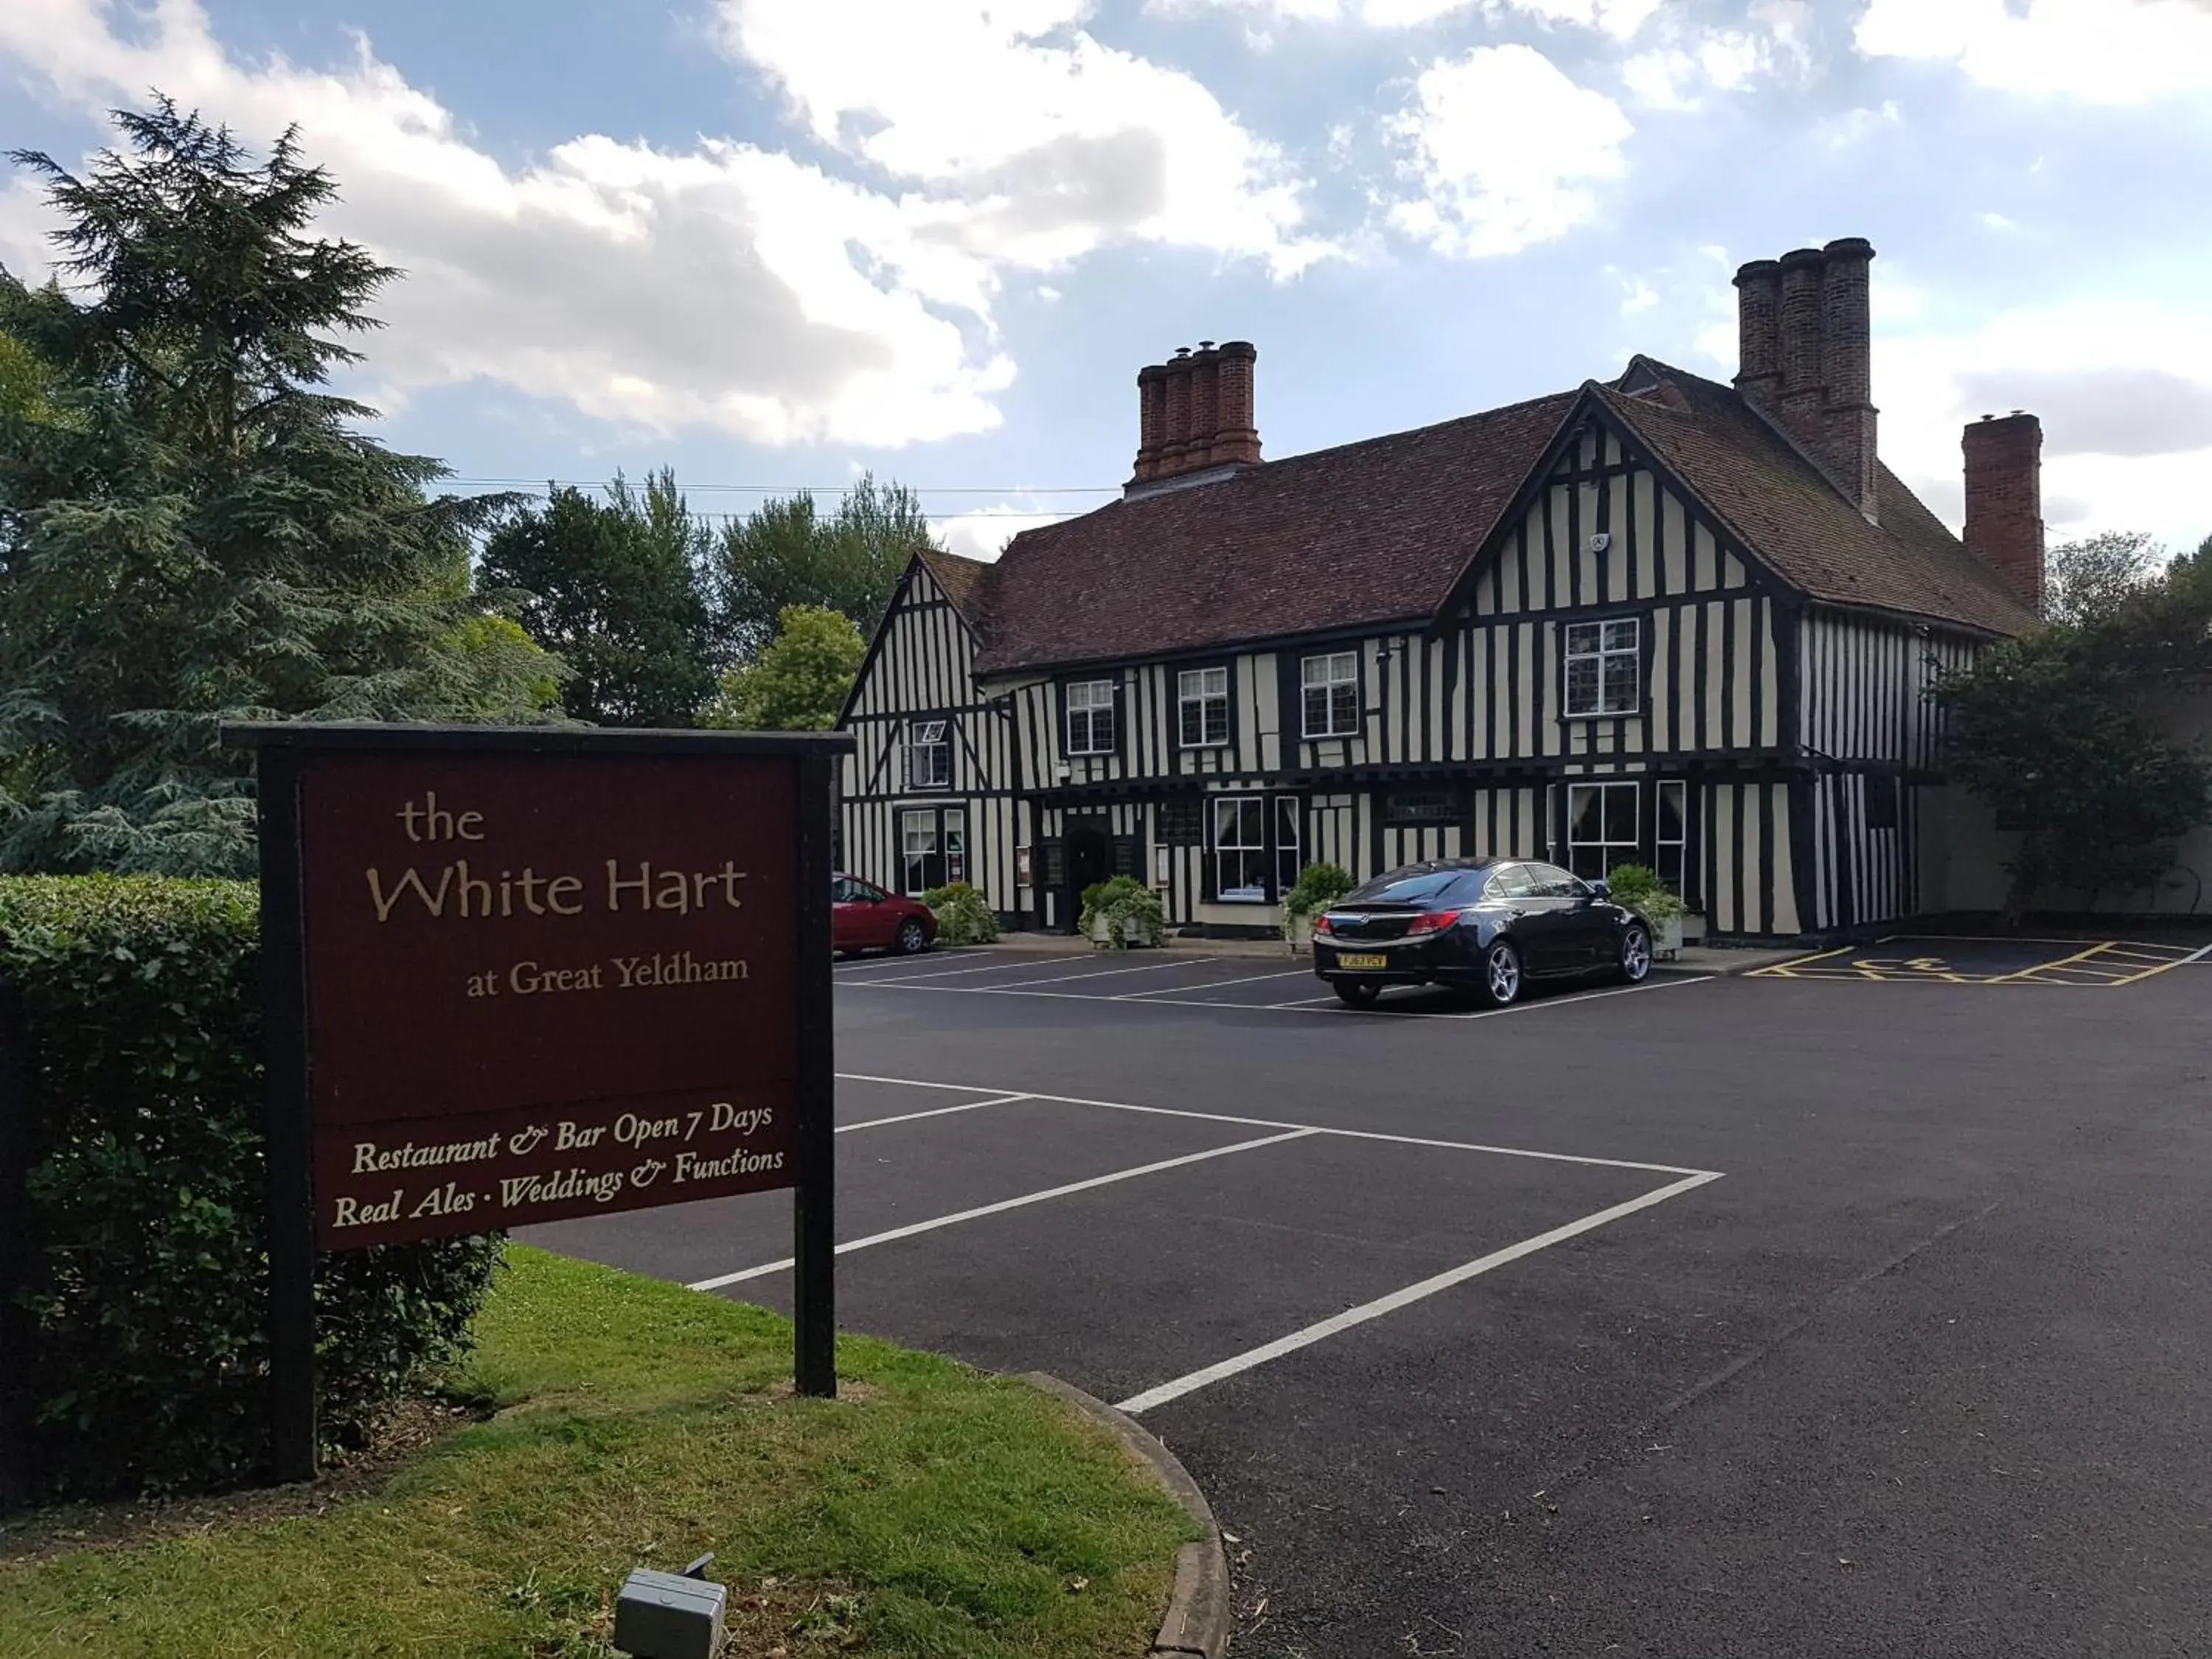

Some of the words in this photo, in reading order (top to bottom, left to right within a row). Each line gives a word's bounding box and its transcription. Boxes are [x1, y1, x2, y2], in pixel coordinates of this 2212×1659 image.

[397, 790, 484, 842] the
[366, 859, 582, 922] White
[606, 859, 747, 915] Hart
[467, 970, 498, 998] at
[509, 961, 602, 994] Great
[611, 950, 748, 987] Yeldham
[352, 1132, 501, 1174] Restaurant
[509, 1125, 549, 1155] &
[554, 1121, 606, 1151] Bar
[614, 1113, 678, 1149] Open
[685, 1112, 703, 1141] 7
[709, 1103, 773, 1135] Days
[333, 1189, 402, 1227] Real
[408, 1182, 476, 1219] Ales
[500, 1168, 625, 1208] Weddings
[630, 1158, 667, 1187] &
[673, 1148, 785, 1183] Functions
